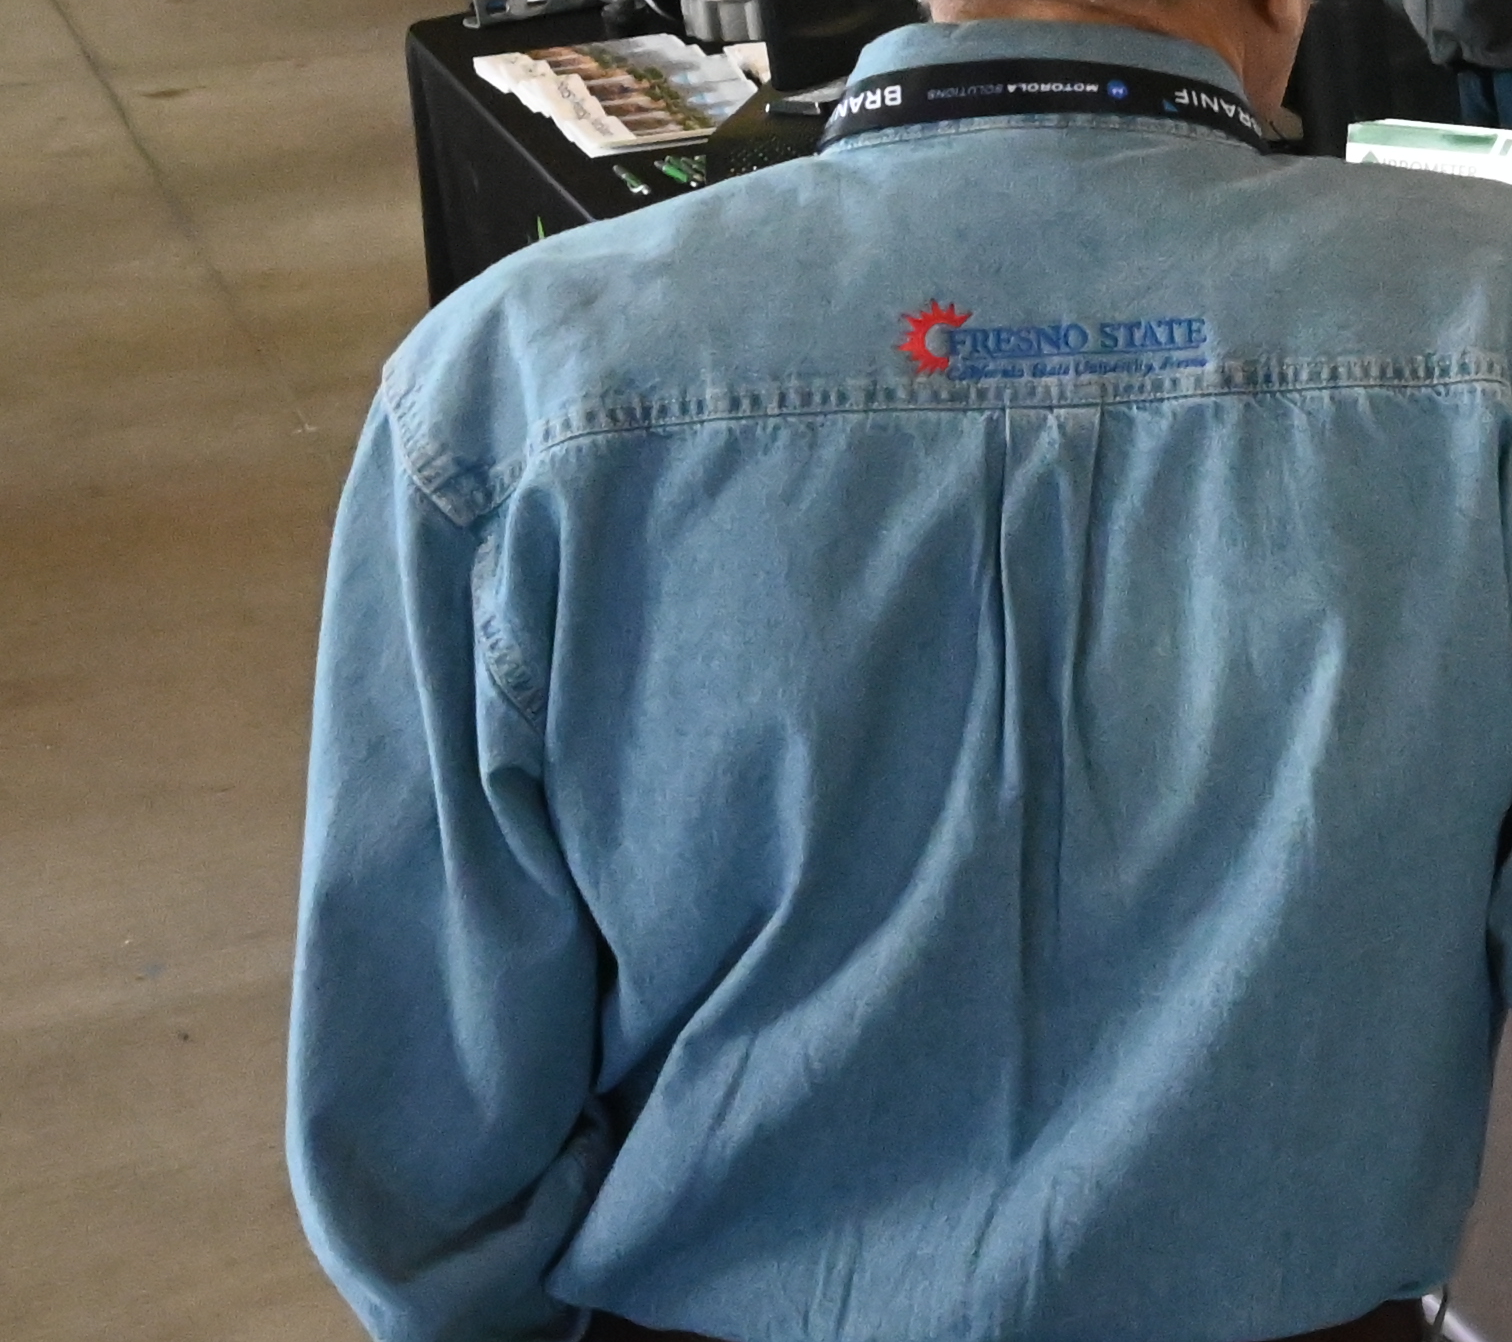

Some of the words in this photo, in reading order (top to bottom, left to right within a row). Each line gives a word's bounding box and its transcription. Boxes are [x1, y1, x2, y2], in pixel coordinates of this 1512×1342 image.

[1007, 81, 1099, 94] MOTOROLA
[951, 323, 1090, 358] FRESNO
[1100, 318, 1208, 350] STATE
